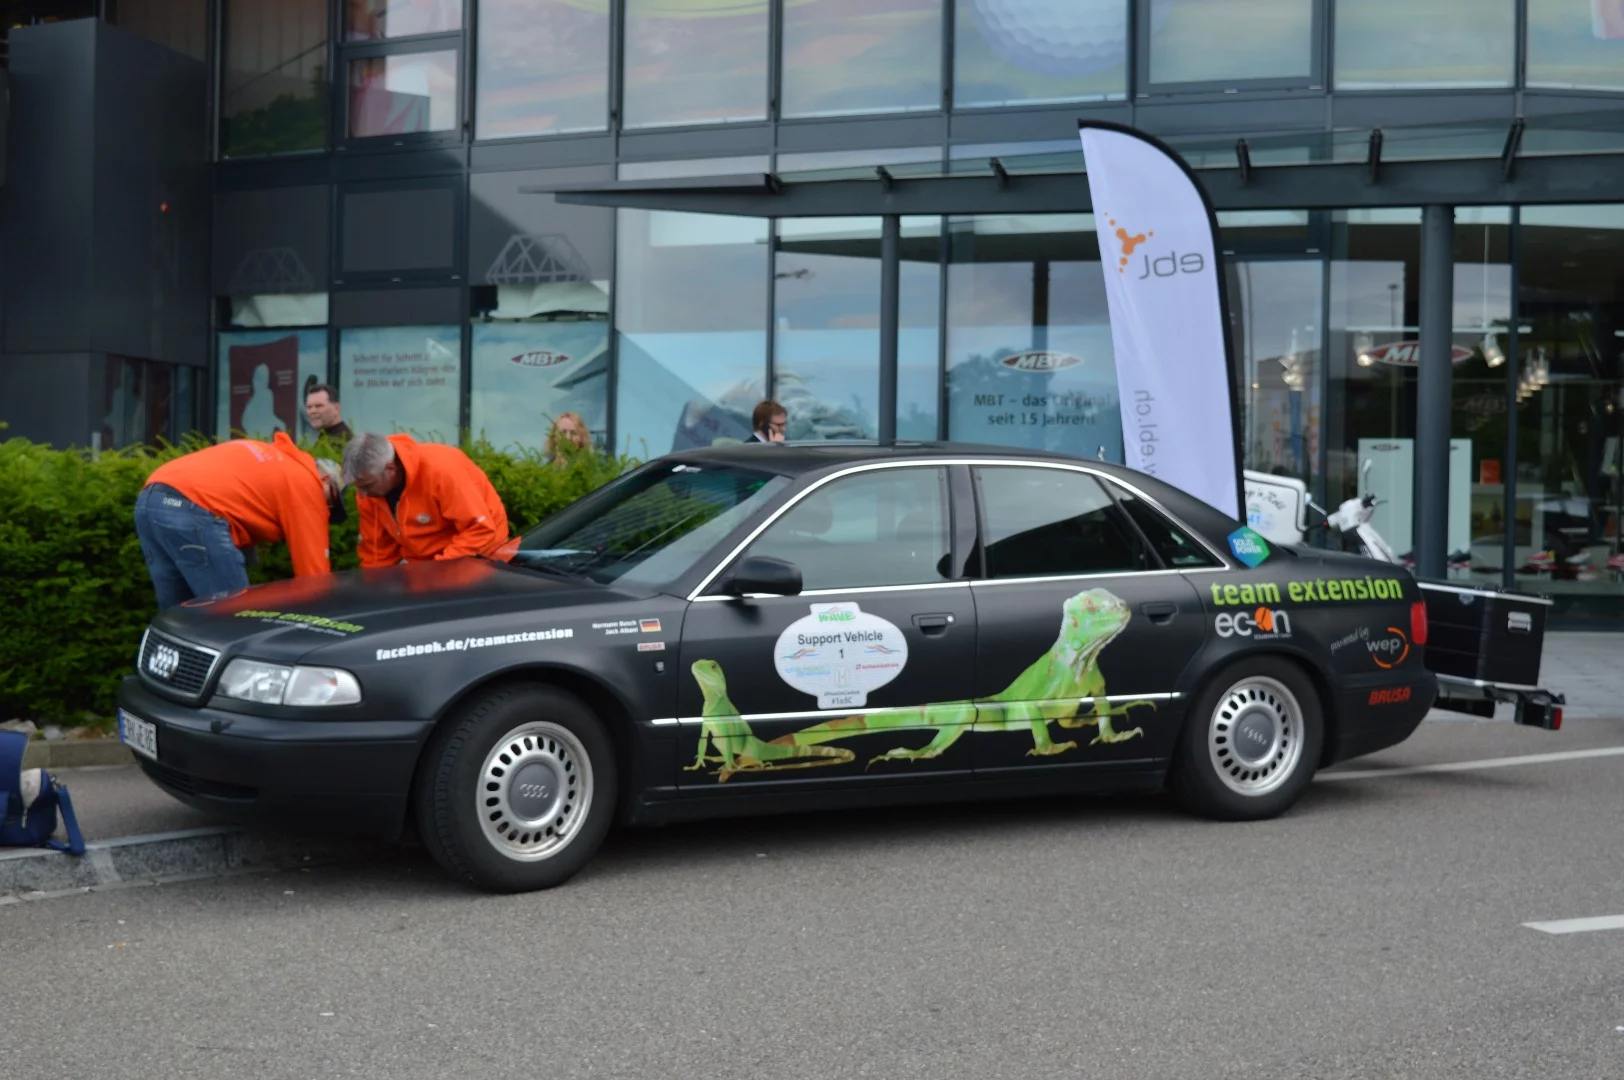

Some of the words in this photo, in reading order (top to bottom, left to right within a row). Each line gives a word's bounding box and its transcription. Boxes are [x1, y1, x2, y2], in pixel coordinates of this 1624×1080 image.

[973, 394, 1004, 407] MBT
[1022, 393, 1047, 407] das
[987, 411, 1015, 425] seit
[1021, 411, 1038, 425] 15
[1210, 581, 1281, 606] team
[1287, 575, 1403, 603] extension
[818, 611, 855, 622] WAVE
[376, 628, 574, 661] facebook.de/teamextension
[797, 633, 842, 646] Support
[844, 630, 884, 643] Vehicle
[839, 648, 845, 660] 1
[1366, 638, 1401, 655] wep
[1368, 686, 1412, 705] BRUSA
